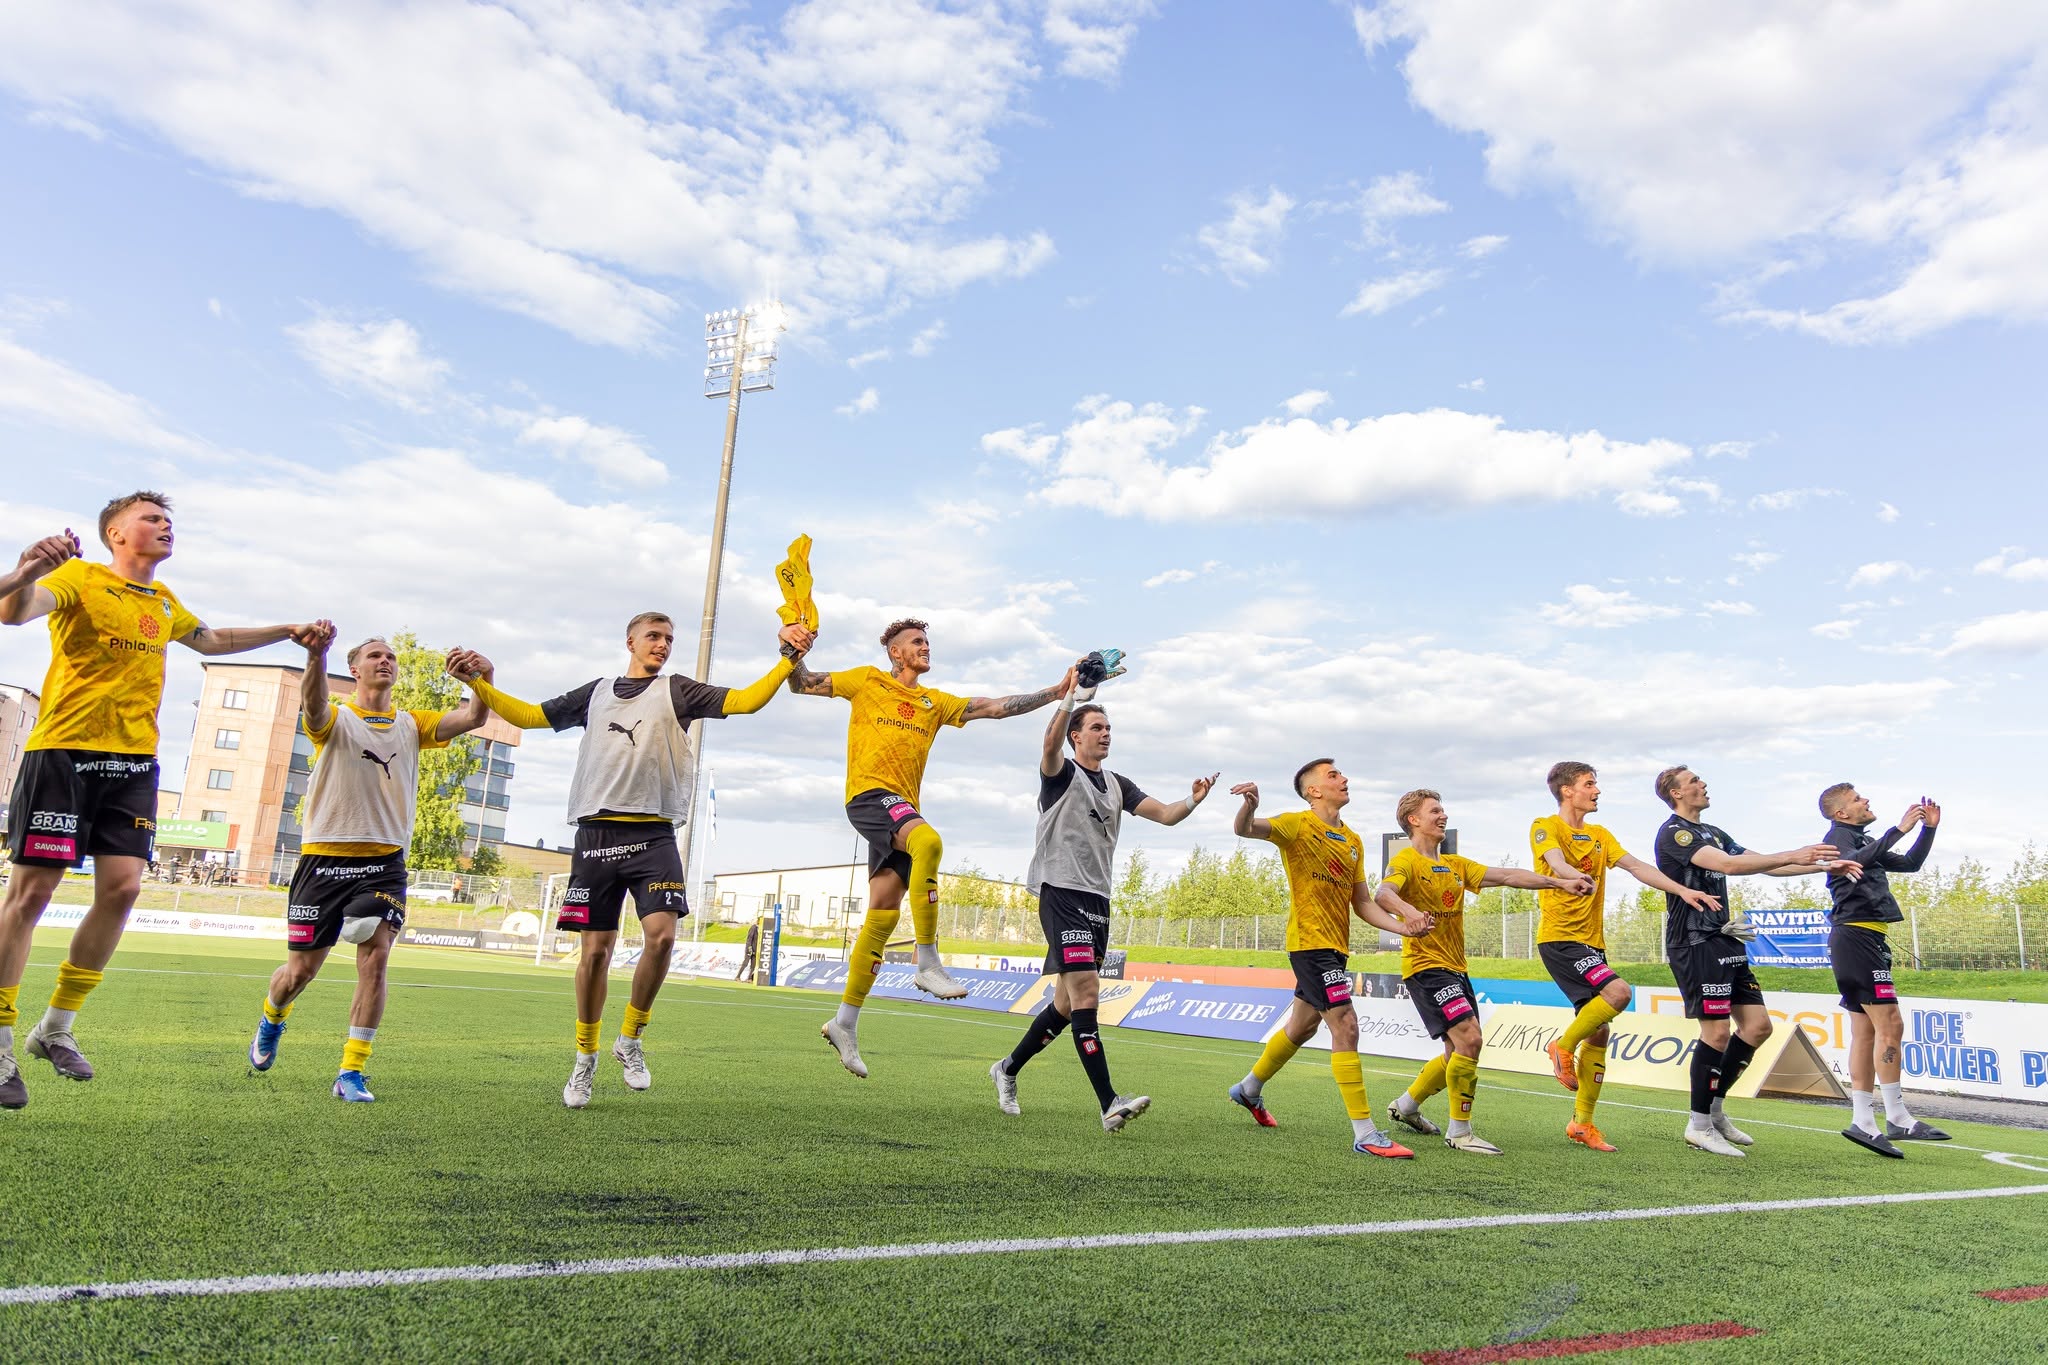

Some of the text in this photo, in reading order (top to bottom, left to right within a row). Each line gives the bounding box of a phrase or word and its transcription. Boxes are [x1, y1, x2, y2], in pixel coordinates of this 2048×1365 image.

[86, 761, 152, 773] INTERSPORT
[32, 814, 78, 830] GRANO
[34, 842, 72, 853] SAVONIA
[590, 841, 650, 858] INTERSPORT
[324, 864, 386, 876] INTERSPORT
[665, 891, 672, 905] 2
[1751, 926, 1832, 935] VESITIEKULJETU
[1061, 932, 1093, 942] GRANO
[1753, 954, 1832, 964] VESISTÖRAKENTA
[1702, 984, 1732, 994] GRANO
[1178, 999, 1276, 1024] TRUBE
[1911, 1008, 1966, 1046] ICE
[1900, 1041, 2003, 1085] OWER
